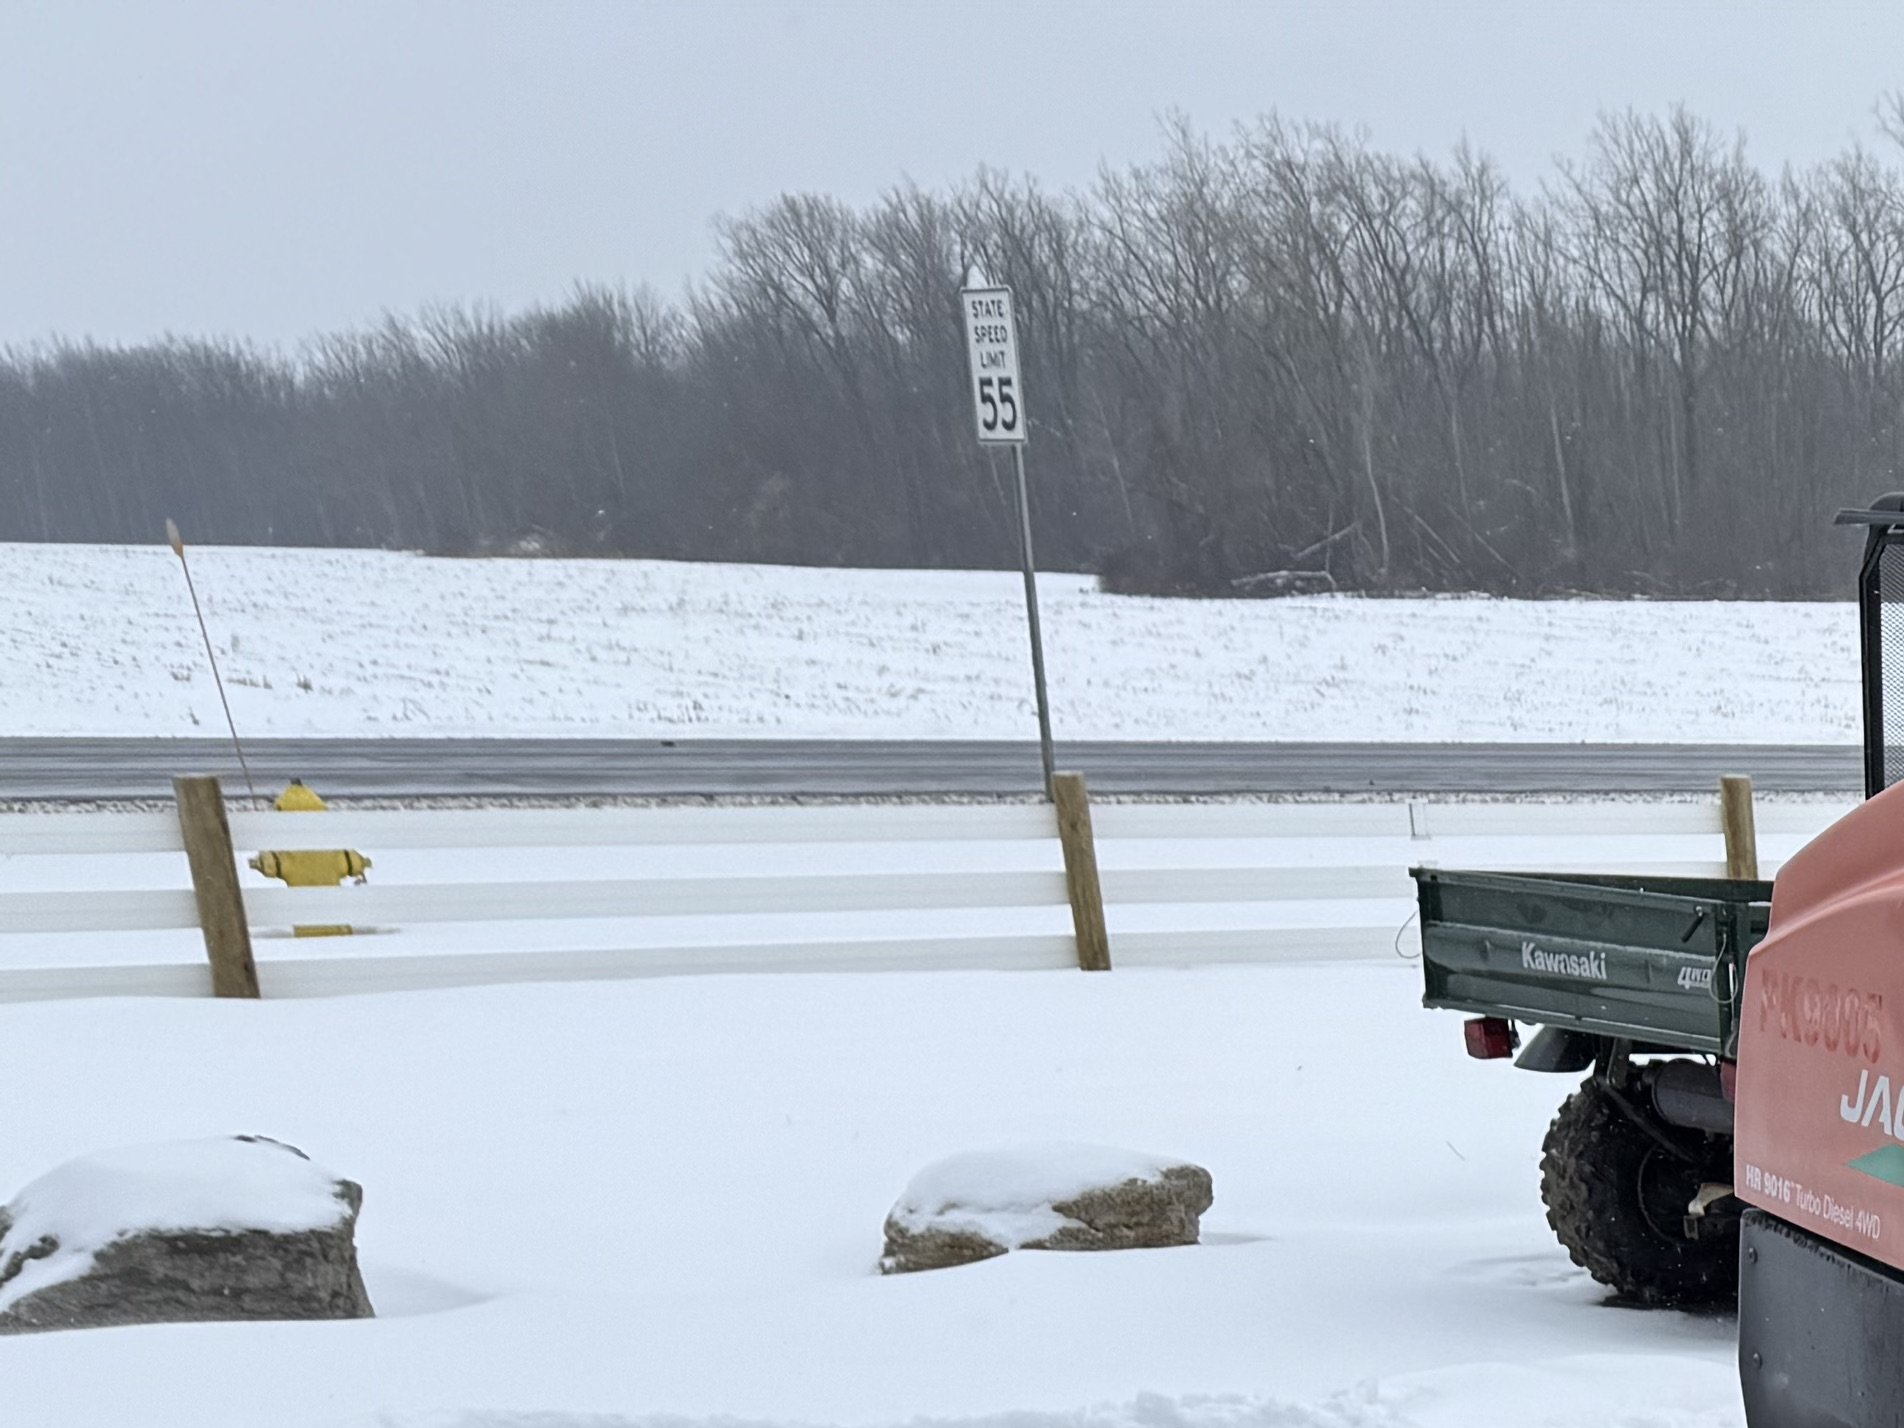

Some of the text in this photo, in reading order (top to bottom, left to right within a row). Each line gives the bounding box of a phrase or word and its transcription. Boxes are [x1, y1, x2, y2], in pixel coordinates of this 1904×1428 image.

[972, 299, 1004, 318] STATE
[974, 325, 1008, 344] SPEED
[980, 350, 1007, 369] LIMIT
[978, 376, 1017, 432] 55
[1521, 941, 1608, 980] Kawasaki
[1745, 1164, 1762, 1192] HR
[1795, 1183, 1822, 1216] Turbo
[1823, 1194, 1854, 1230] Diesel
[1855, 1209, 1881, 1239] 4WD
